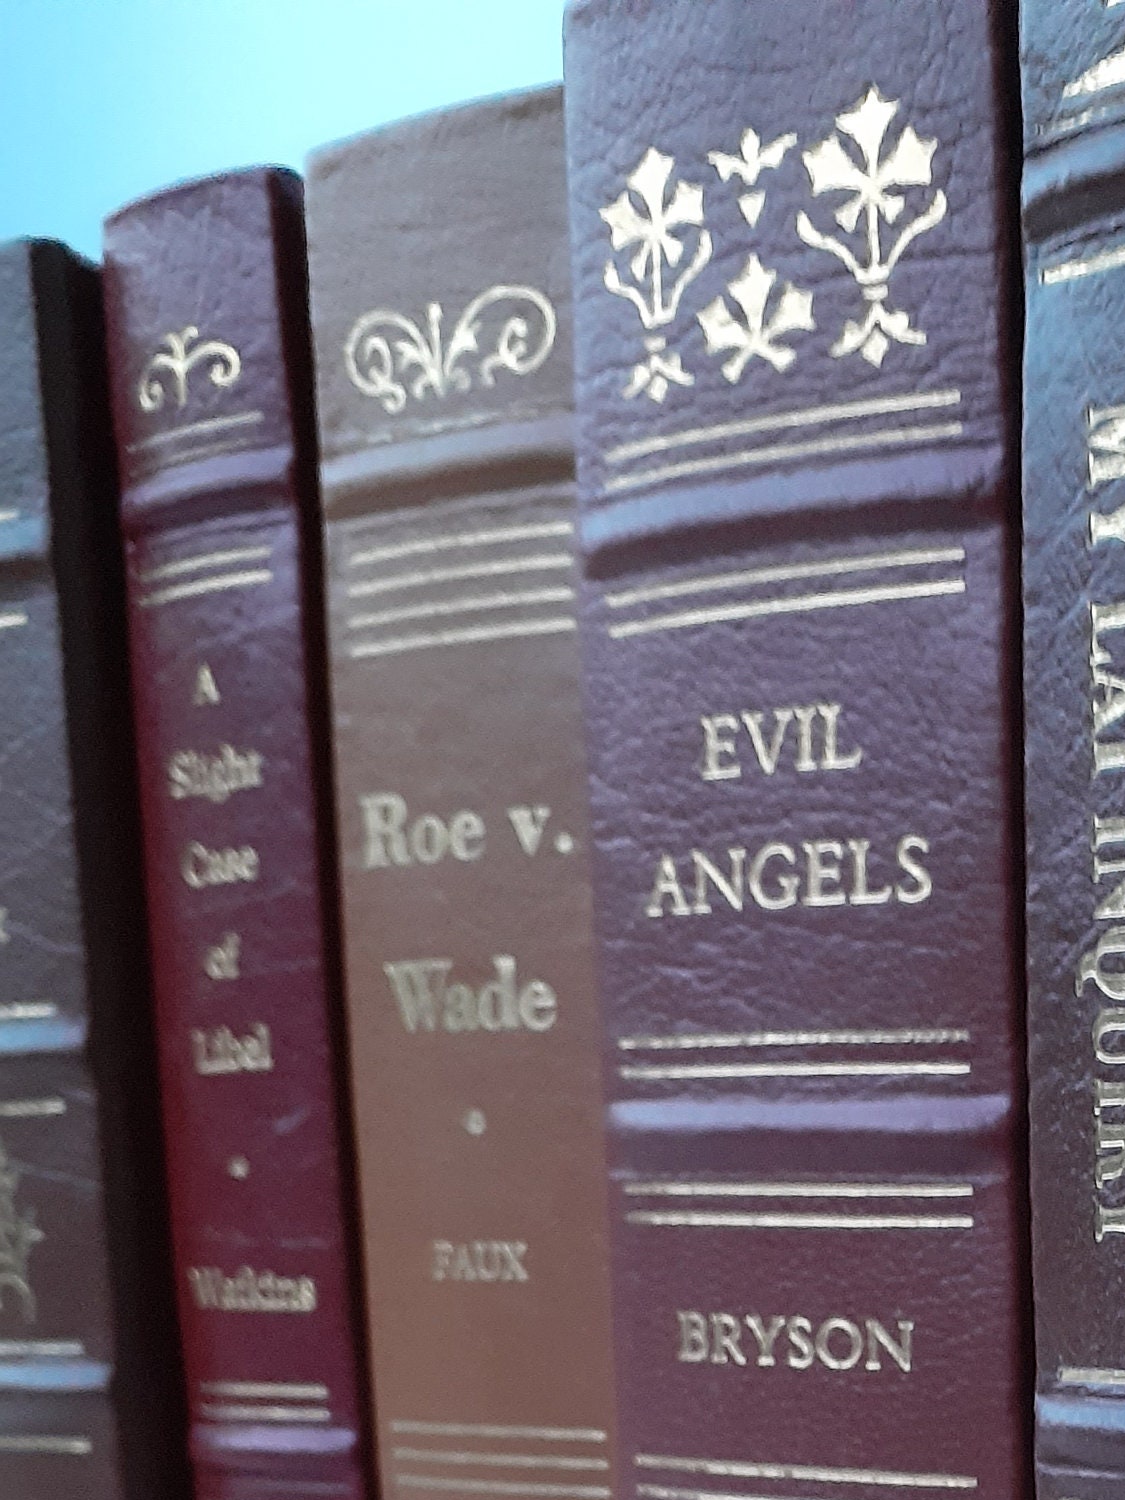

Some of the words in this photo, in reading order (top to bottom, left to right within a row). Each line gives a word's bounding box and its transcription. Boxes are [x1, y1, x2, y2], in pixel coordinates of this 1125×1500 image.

[701, 703, 862, 782] EVIL
[357, 792, 486, 869] Roe
[507, 805, 575, 857] v.
[646, 835, 933, 918] ANGELS
[382, 953, 559, 1034] Wade
[431, 1238, 530, 1283] FAUX
[676, 1309, 914, 1373] BRYSON
